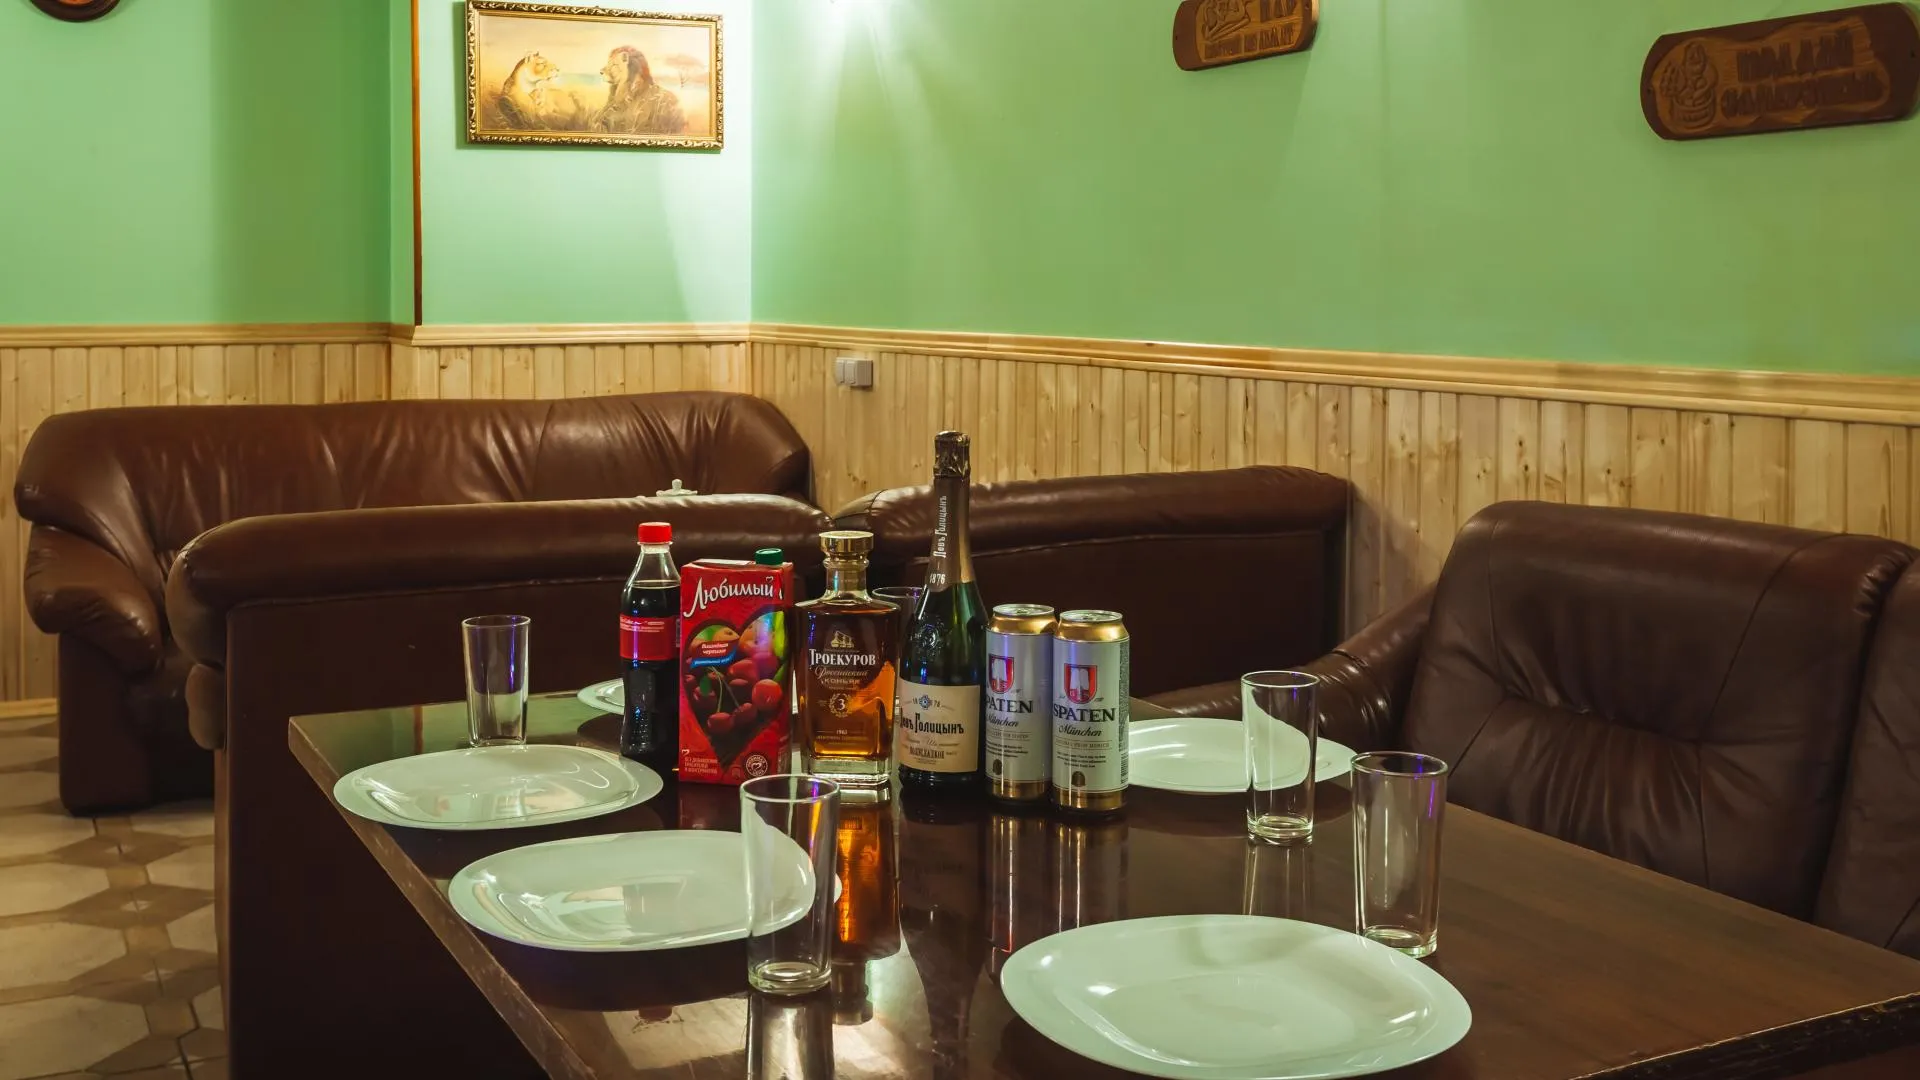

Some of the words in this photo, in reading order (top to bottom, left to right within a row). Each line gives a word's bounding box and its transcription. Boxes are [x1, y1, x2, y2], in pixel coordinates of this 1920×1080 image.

[683, 576, 774, 618] Любимый
[808, 648, 876, 667] ТРОЕКУРОВ
[837, 698, 846, 711] 3
[985, 694, 1033, 714] PATEN
[1053, 703, 1116, 723] SPATEN
[914, 712, 965, 735] Голицынъ
[1058, 723, 1103, 737] München
